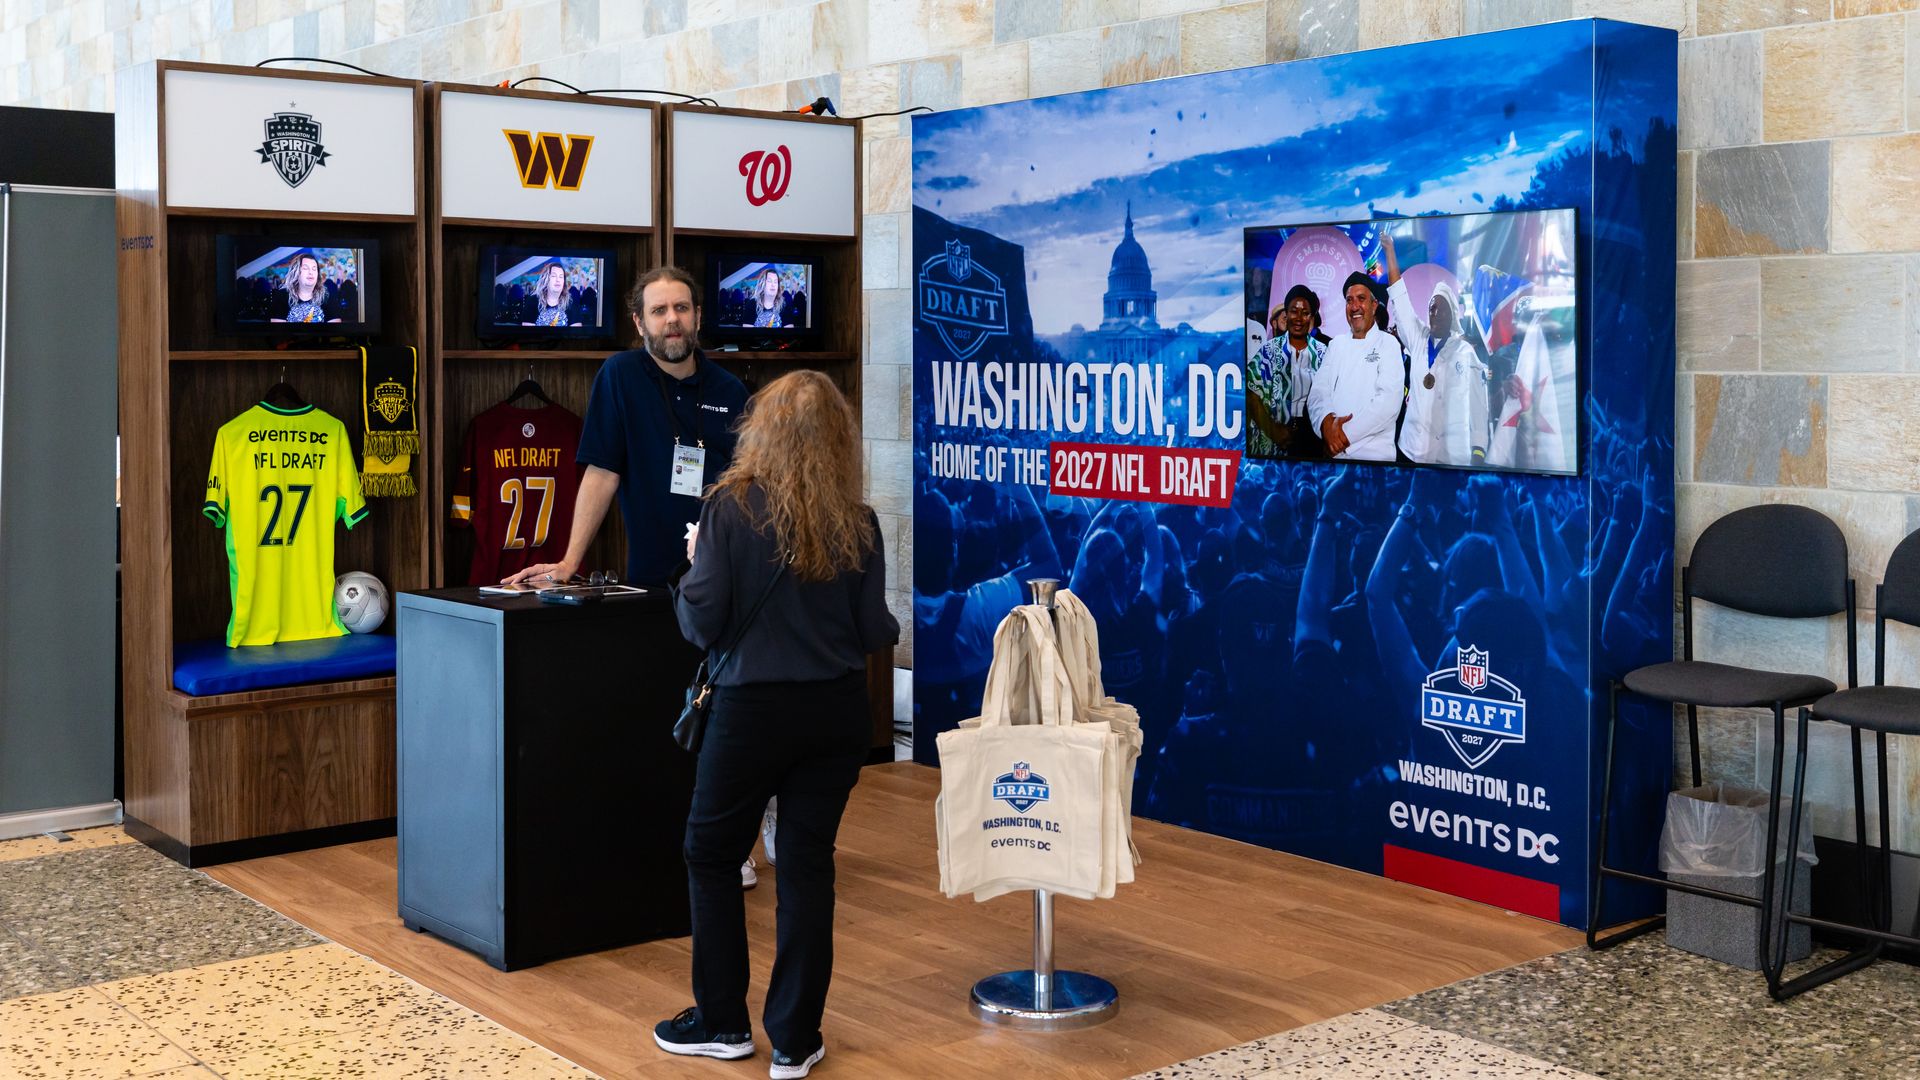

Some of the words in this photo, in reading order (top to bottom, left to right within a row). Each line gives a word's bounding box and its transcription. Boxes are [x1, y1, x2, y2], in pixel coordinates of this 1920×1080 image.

[271, 139, 316, 153] SPIRIT
[502, 129, 595, 191] W
[738, 145, 792, 207] W
[1296, 243, 1347, 266] EMBASSY
[927, 288, 999, 321] DRAFT
[954, 329, 971, 339] 2027
[932, 361, 1176, 448] WASHINGTON,
[1188, 362, 1243, 440] DC
[254, 453, 277, 470] NFL
[282, 452, 326, 470] DRAFT
[494, 448, 518, 468] NFL
[521, 447, 561, 467] DRAFT
[932, 442, 981, 481] HOME
[985, 447, 1008, 483] OF
[1011, 448, 1047, 486] THE
[1055, 450, 1107, 490] 2027
[1112, 453, 1150, 493] NFL
[1160, 455, 1231, 499] DRAFT
[258, 484, 313, 547] 27
[500, 476, 556, 550] 27
[1462, 665, 1484, 686] NFL
[1430, 697, 1516, 729] DRAFT
[1462, 734, 1483, 745] 2027
[1015, 769, 1028, 778] NFL
[997, 785, 1046, 797] DRAFT
[1399, 760, 1512, 807] WASHINGTON,
[1516, 783, 1550, 811] D.C.
[982, 816, 1043, 832] WASHINGTON,
[1045, 821, 1062, 834] D.C.
